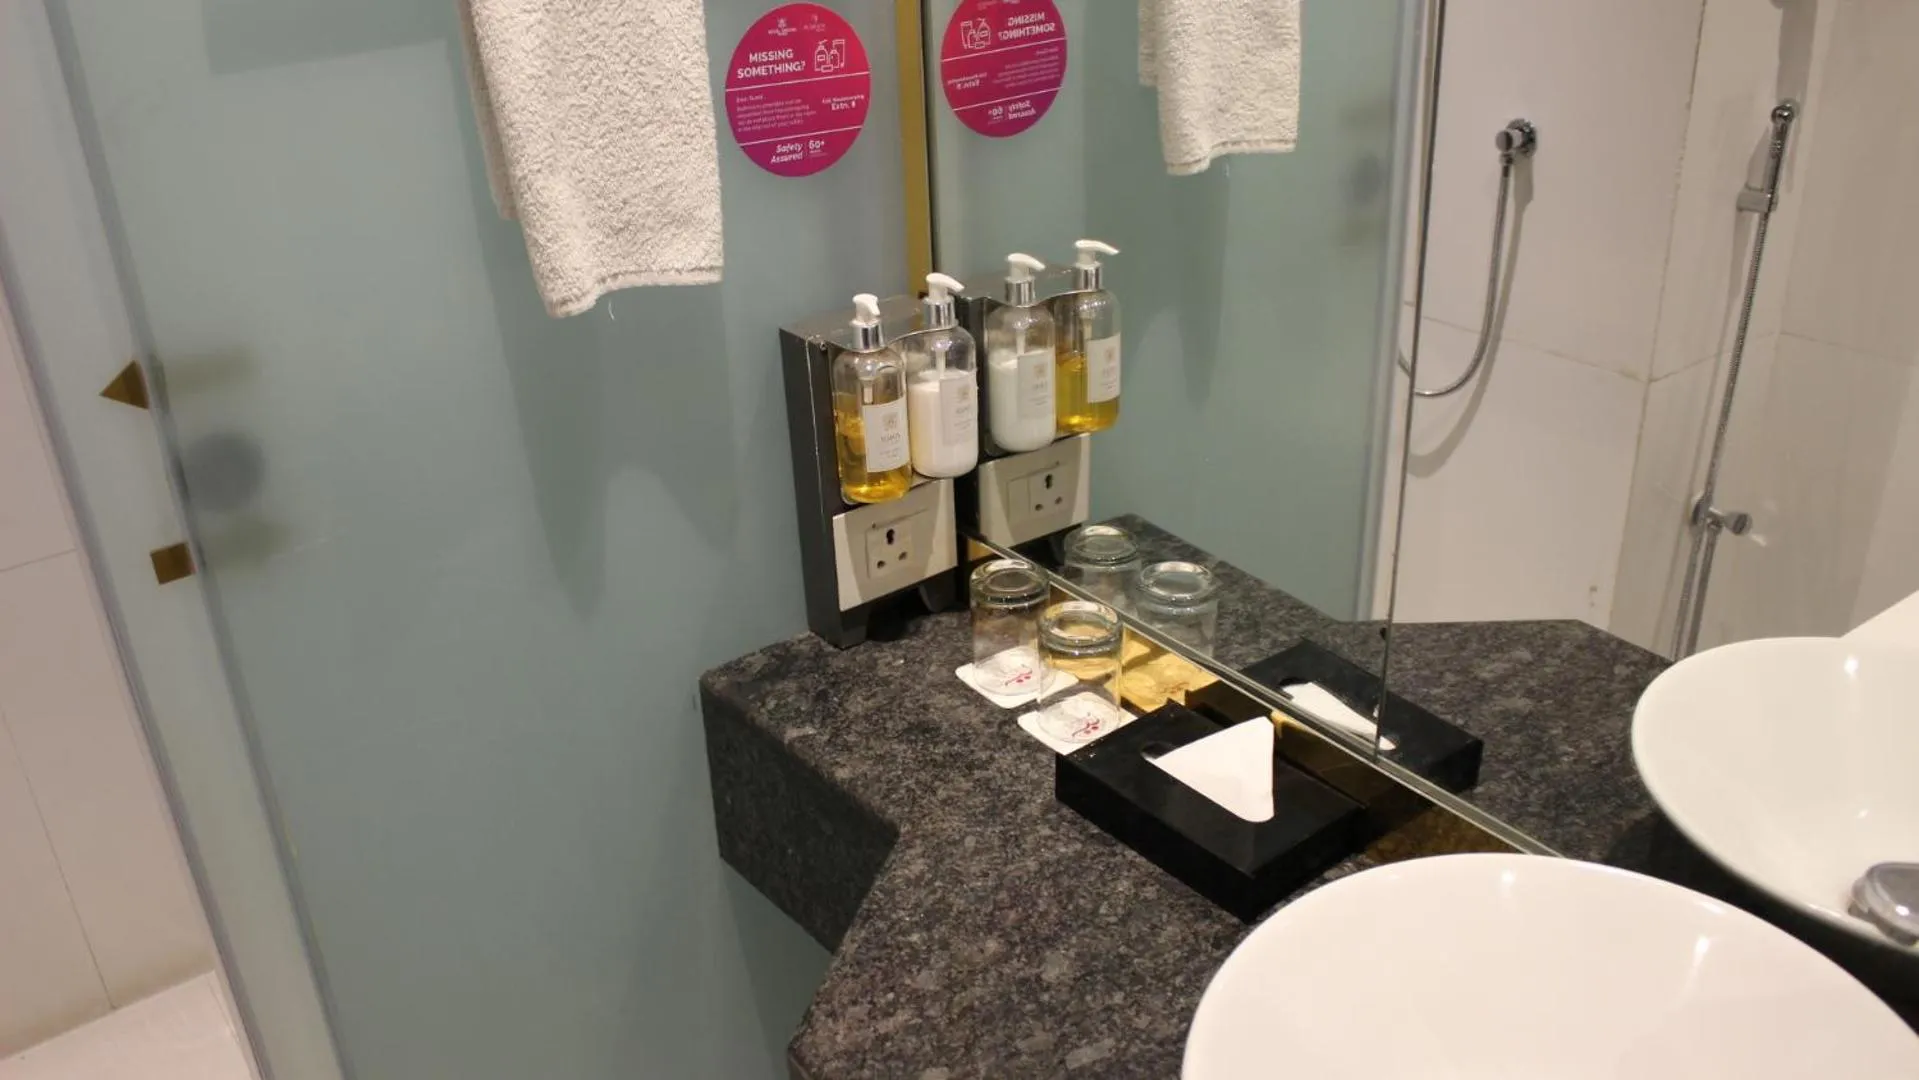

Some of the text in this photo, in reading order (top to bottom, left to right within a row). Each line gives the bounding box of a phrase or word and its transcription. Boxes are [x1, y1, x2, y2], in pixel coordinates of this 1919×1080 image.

[749, 49, 793, 63] MISSING
[738, 61, 806, 79] SOMETHING?
[776, 139, 825, 154] Safety 60+
[771, 151, 803, 164] Assured
